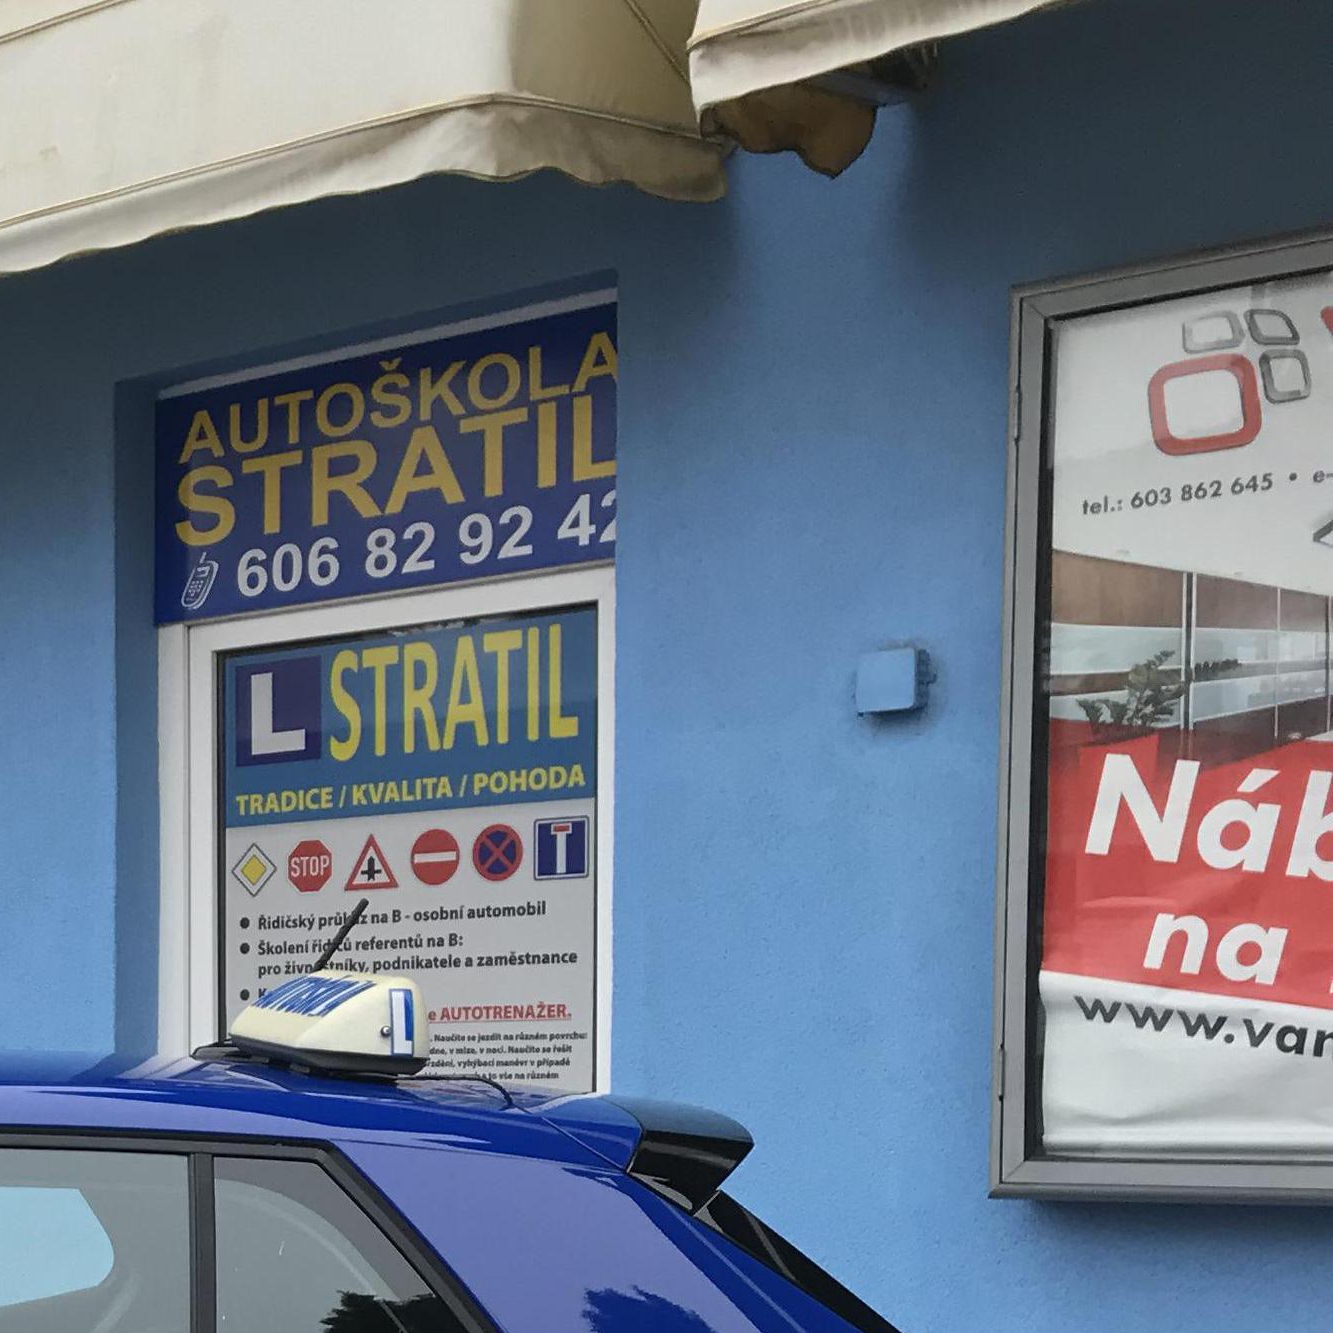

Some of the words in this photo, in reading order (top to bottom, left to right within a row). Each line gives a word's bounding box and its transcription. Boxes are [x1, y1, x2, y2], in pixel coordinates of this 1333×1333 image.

[179, 331, 617, 464] AUTOŠKOLA
[175, 394, 617, 547] STRATIL
[1082, 495, 1123, 515] tel.:
[1130, 486, 1171, 509] 603
[1181, 479, 1222, 501] 862
[1231, 472, 1273, 496] 645
[237, 536, 340, 598] 606
[365, 521, 435, 578] 82
[458, 505, 534, 565] 92
[250, 671, 307, 756] L
[329, 623, 579, 762] STRATIL
[236, 786, 333, 817] TRADICE
[352, 776, 453, 806] KVALITA
[473, 764, 586, 796] POHODA
[290, 854, 330, 878] STOP
[258, 913, 315, 931] Řidičský
[318, 911, 368, 930] průz
[371, 912, 389, 924] na
[392, 908, 402, 923] B
[413, 904, 465, 922] osobní
[467, 900, 547, 919] automobil
[258, 939, 309, 955] Školení
[356, 933, 423, 951] referentů
[427, 936, 445, 948] na
[449, 932, 464, 947] B:
[258, 964, 282, 979] pro
[373, 954, 461, 973] podnikatele
[465, 956, 474, 968] a
[477, 951, 578, 967] zaměstnance
[1143, 912, 1288, 986] na
[440, 1000, 572, 1021] AUTOTRENAŽER.
